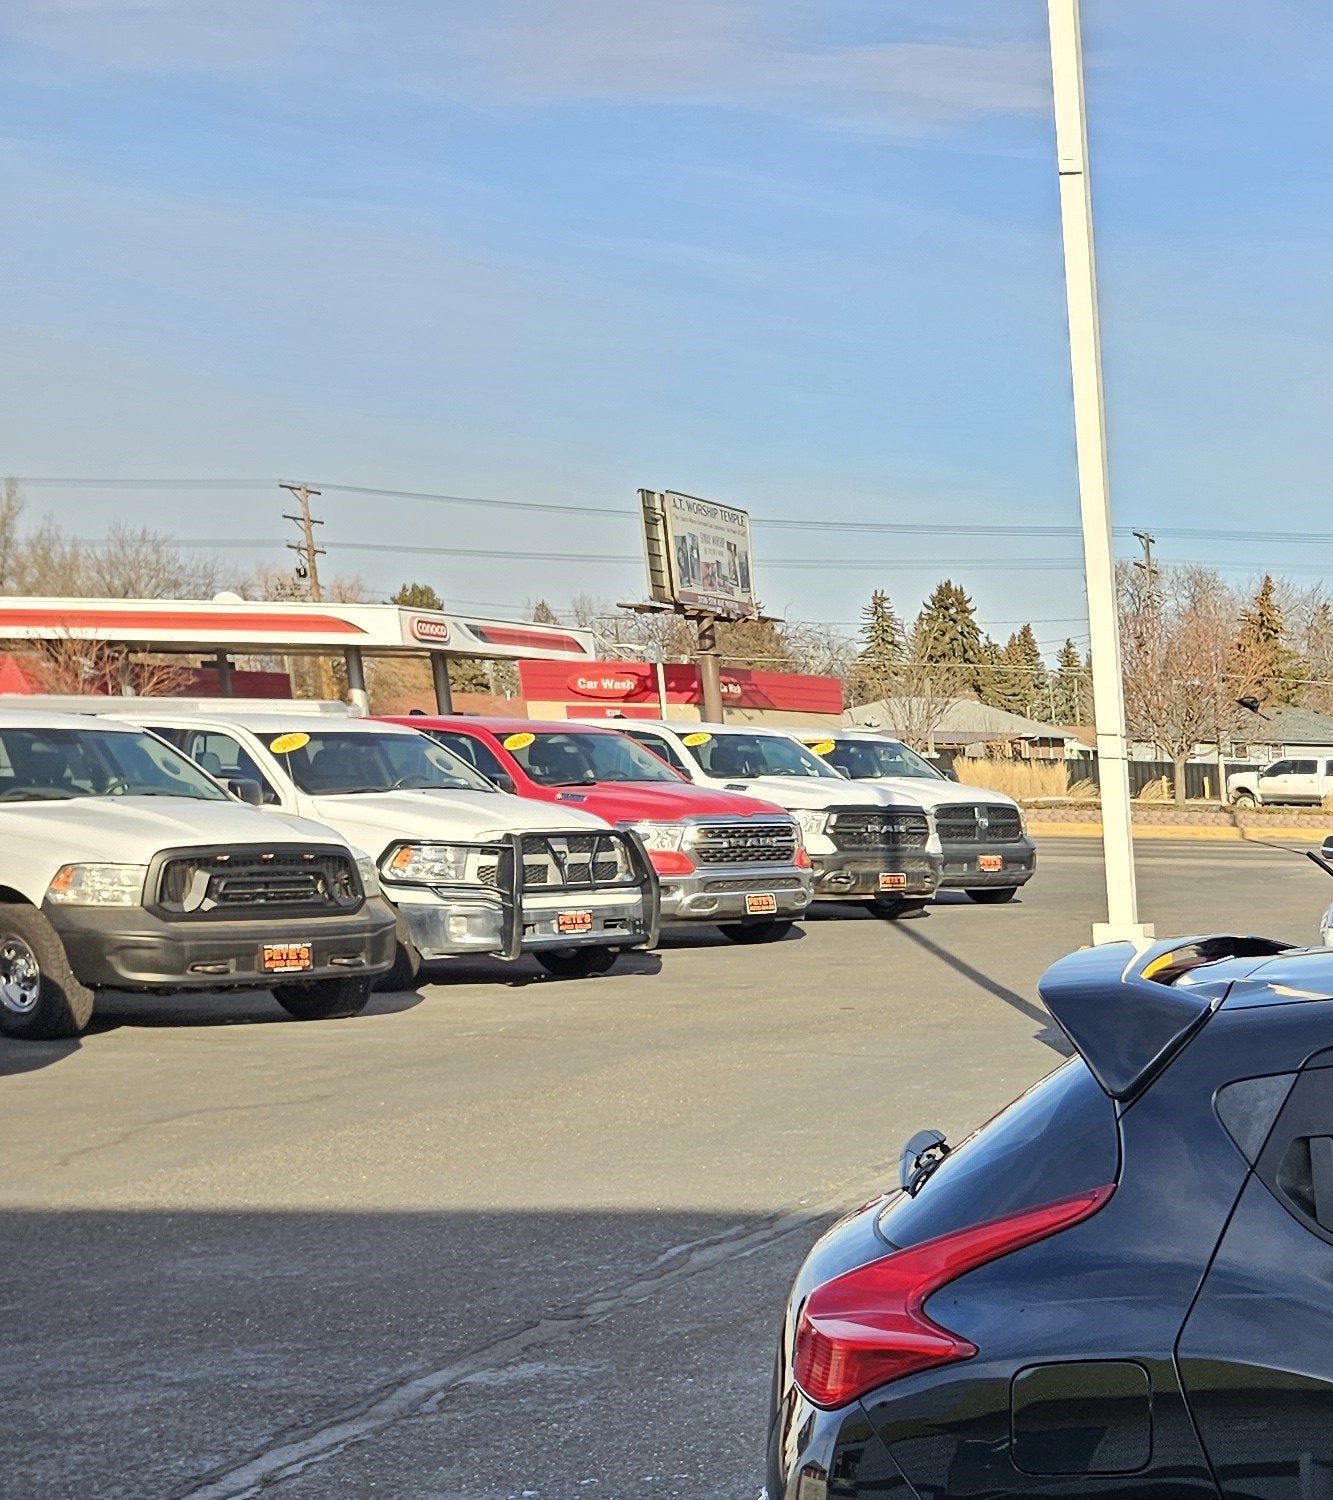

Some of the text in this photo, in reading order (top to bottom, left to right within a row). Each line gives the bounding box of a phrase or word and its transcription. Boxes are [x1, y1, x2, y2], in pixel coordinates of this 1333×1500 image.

[687, 500, 718, 519] WORSHIP
[720, 509, 746, 528] TEMPLE
[577, 677, 635, 691] Car Wash
[866, 824, 907, 833] RAM
[264, 947, 310, 961] PETE'S
